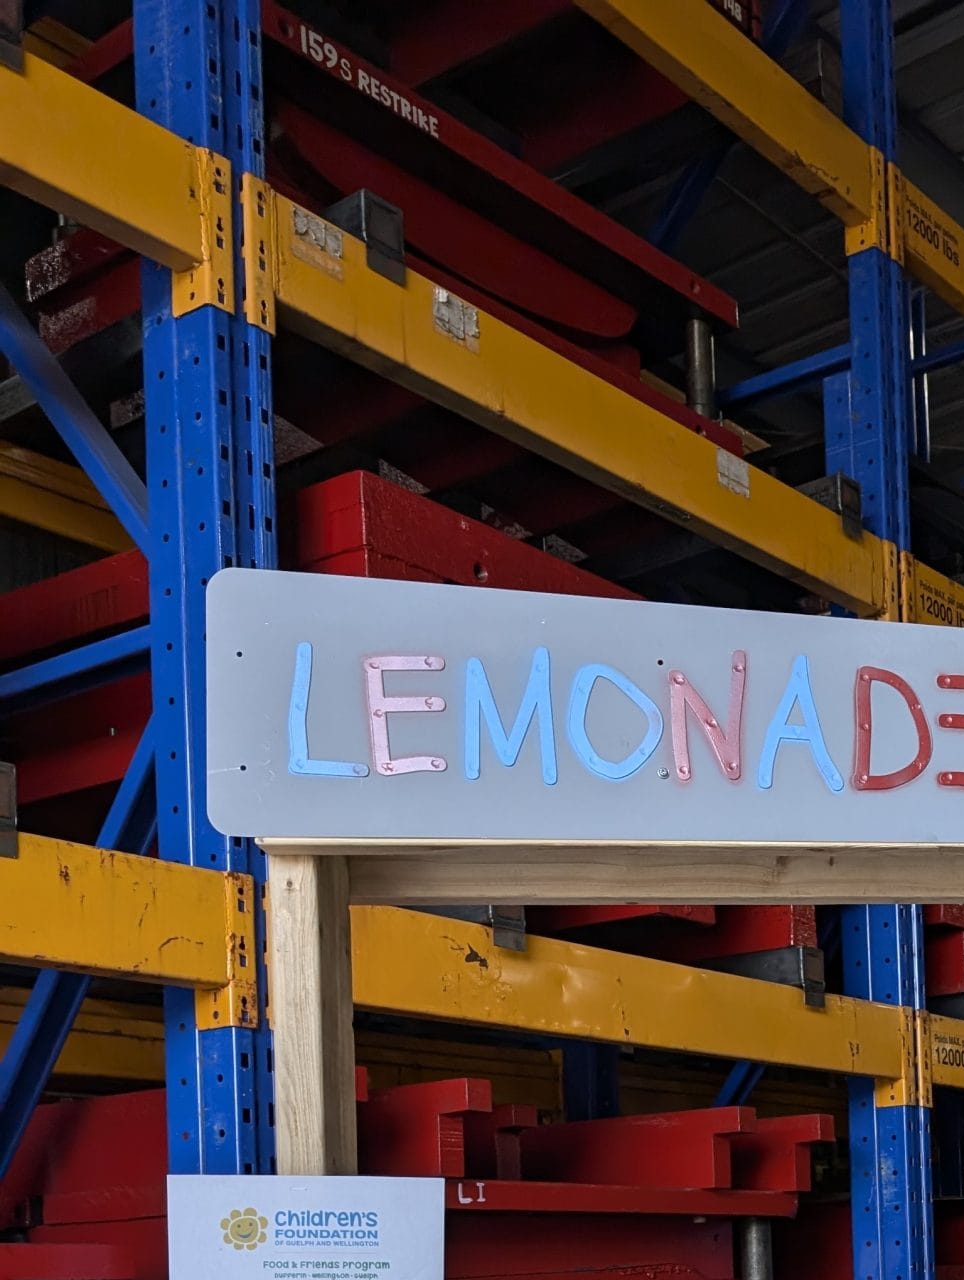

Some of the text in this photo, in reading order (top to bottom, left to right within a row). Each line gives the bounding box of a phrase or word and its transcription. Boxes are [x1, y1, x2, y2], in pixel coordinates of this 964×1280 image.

[357, 68, 440, 138] RESTRIKE
[906, 208, 960, 267] 12000 lbs
[919, 593, 953, 625] 12000
[274, 1229, 378, 1239] FOUNDATION
